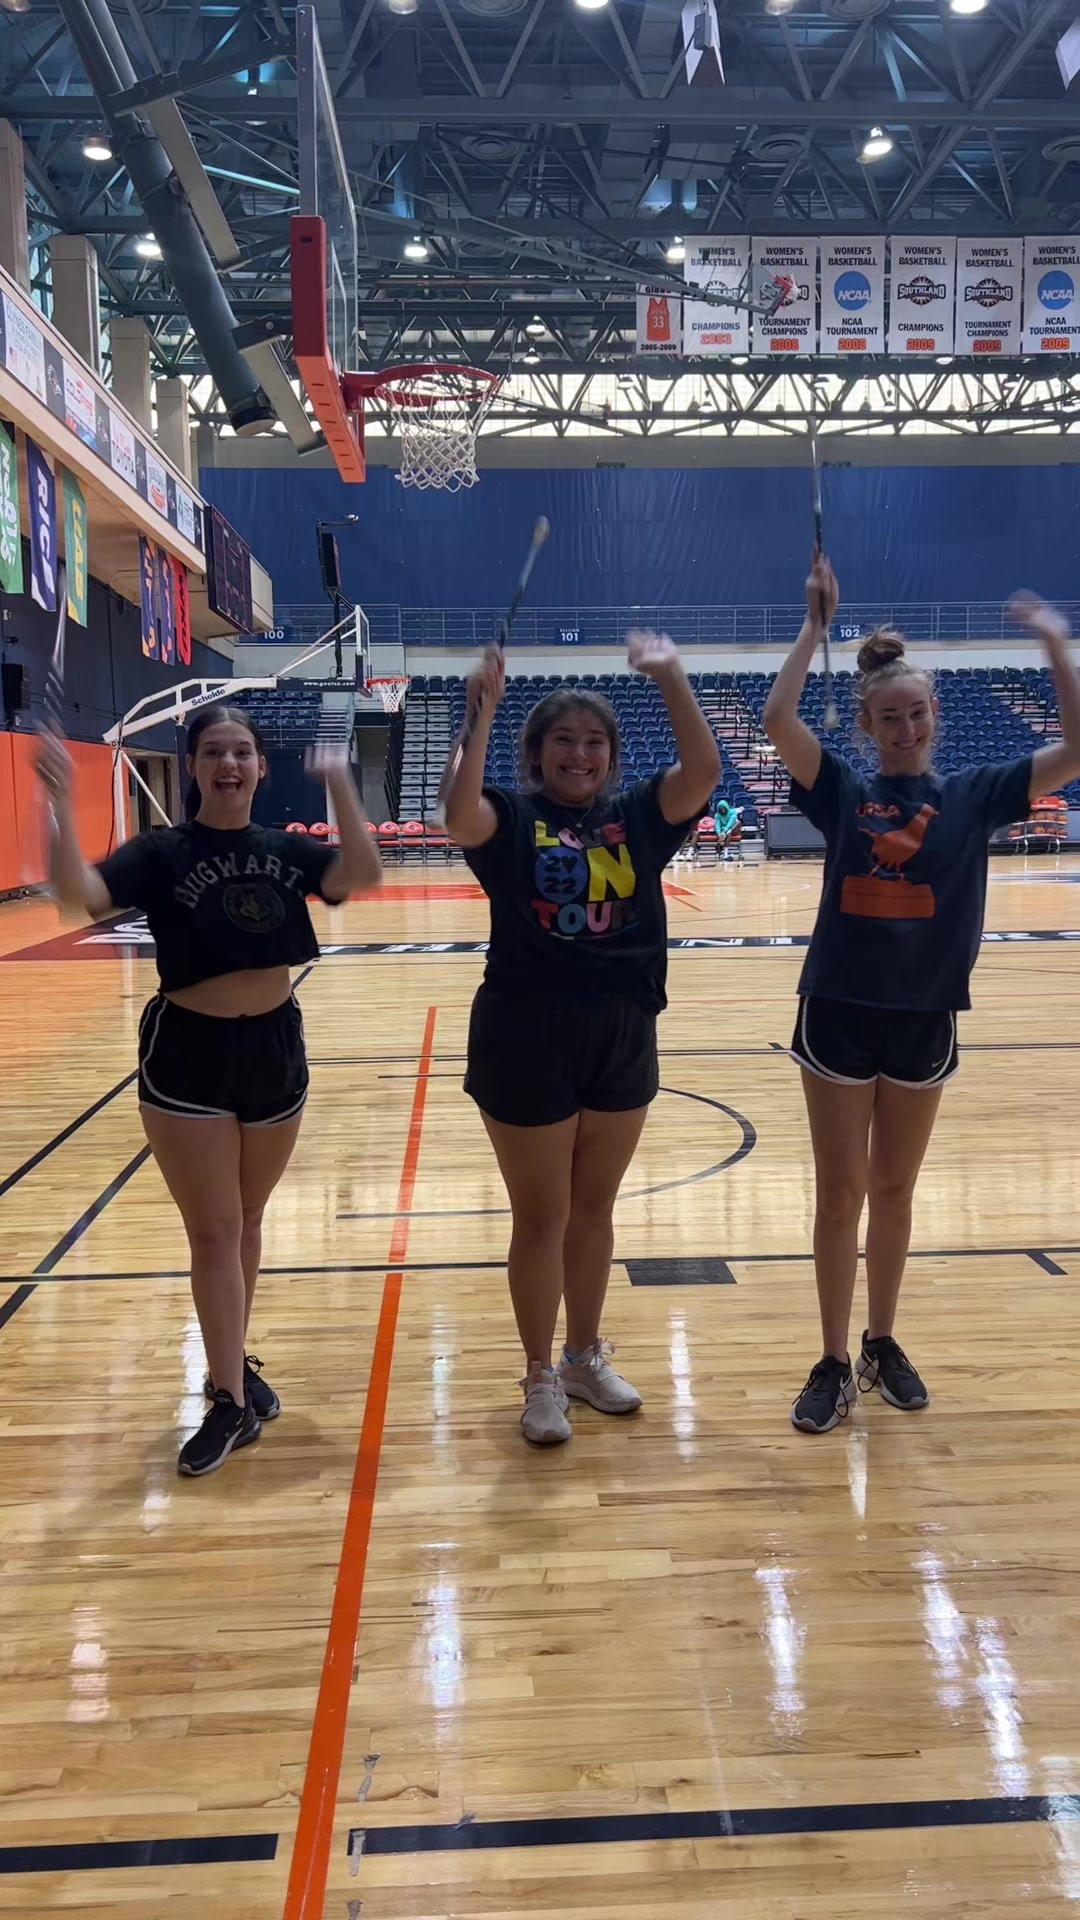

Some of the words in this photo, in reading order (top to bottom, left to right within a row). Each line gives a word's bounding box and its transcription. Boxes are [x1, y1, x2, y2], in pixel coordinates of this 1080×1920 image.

[698, 247, 736, 255] WOMEN'S
[766, 247, 804, 255] WOMEN'S
[834, 247, 872, 255] WOMEN'S
[904, 246, 942, 255] WOMEN'S
[971, 248, 1009, 257] WOMEN'S
[1038, 246, 1076, 255] WOMEN'S
[690, 258, 743, 267] BASKETBALL
[760, 258, 809, 266] BASKETBALL
[828, 257, 877, 266] BASKETBALL
[898, 257, 947, 266] BASKETBALL
[965, 259, 1014, 268] BASKETBALL
[838, 290, 871, 301] NCAA
[899, 284, 946, 299] SOUTHLAND
[966, 287, 1012, 301] SOUTHLAND
[1041, 290, 1075, 301] NCAA
[652, 315, 664, 328] 33
[759, 318, 811, 326] TOURNAMENT
[841, 318, 863, 326] NCAA
[965, 320, 1012, 329] TOURNAMENT
[1045, 317, 1067, 325] NCAA
[691, 322, 741, 332] CHAMPIONS
[761, 327, 808, 335] CHAMPIONS
[826, 327, 878, 335] TOURNAMENT
[898, 323, 944, 332] CHAMPIONS
[1029, 326, 1080, 335] TOURNAMENT
[967, 329, 1009, 338] CHAMPIONS
[770, 338, 799, 351] 2008
[838, 338, 867, 350] 2008
[973, 340, 1002, 352] 2009
[1041, 338, 1070, 350] 2009
[264, 630, 284, 639] 100
[561, 633, 578, 642] 101
[840, 629, 860, 638] 102
[191, 687, 226, 706] Schelde
